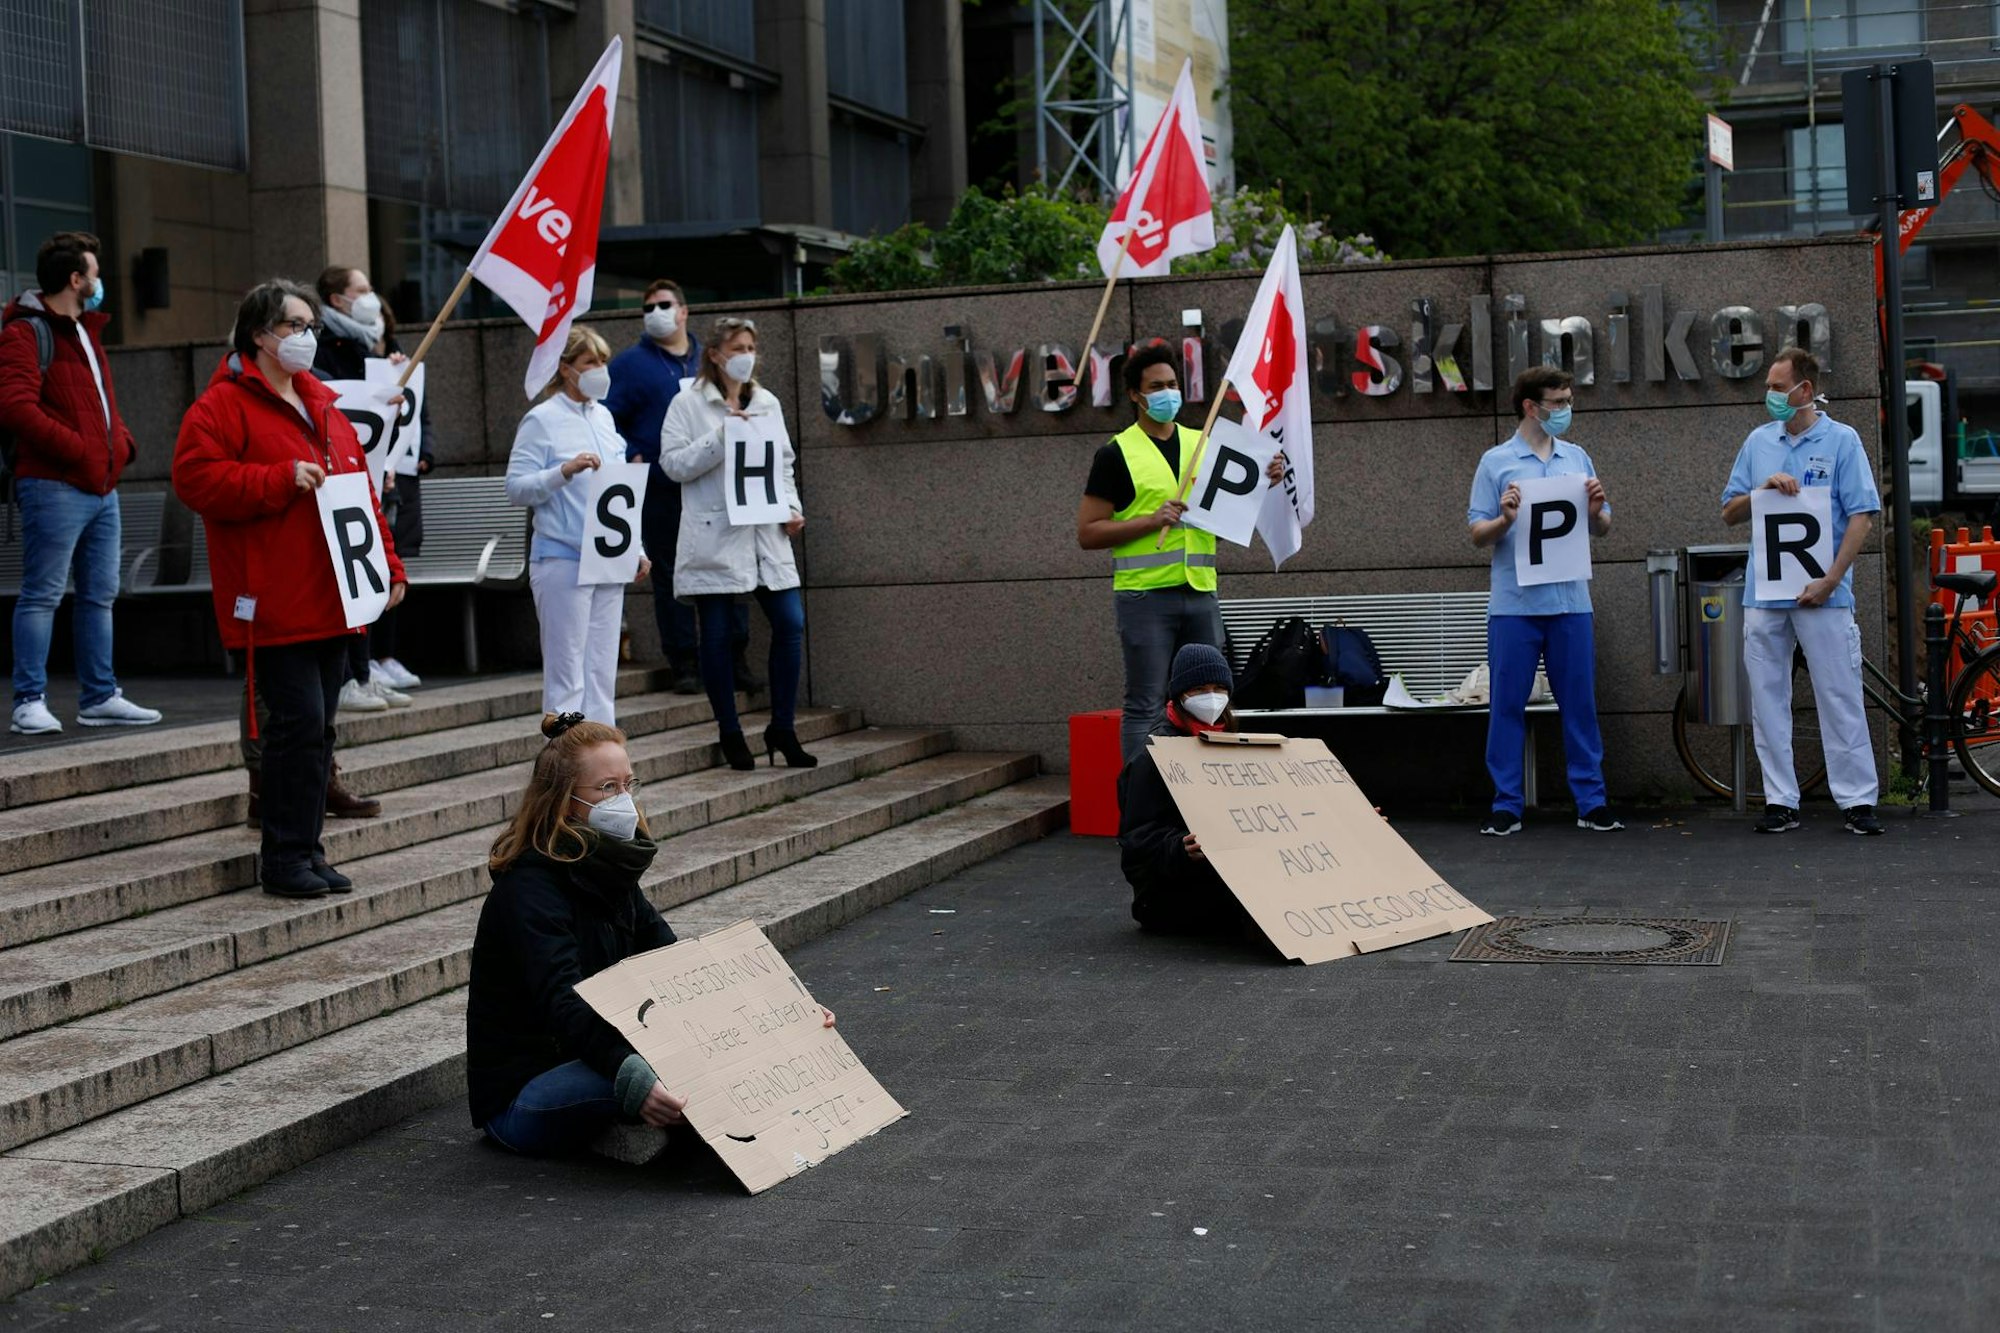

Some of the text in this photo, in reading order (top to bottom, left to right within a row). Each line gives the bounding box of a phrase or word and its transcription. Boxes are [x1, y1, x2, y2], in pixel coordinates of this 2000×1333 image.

[735, 441, 778, 506] H
[1199, 445, 1260, 511] P
[333, 506, 385, 599] R
[594, 484, 635, 558] S
[1529, 500, 1577, 565] P
[1764, 512, 1826, 581] R
[1202, 762, 1279, 787] STEHEN
[1229, 802, 1298, 833] EUCH
[1278, 841, 1341, 877] AUCH
[650, 943, 780, 1008] AUSGEBRANNT
[719, 1038, 859, 1116] VERÄNDERUNG
